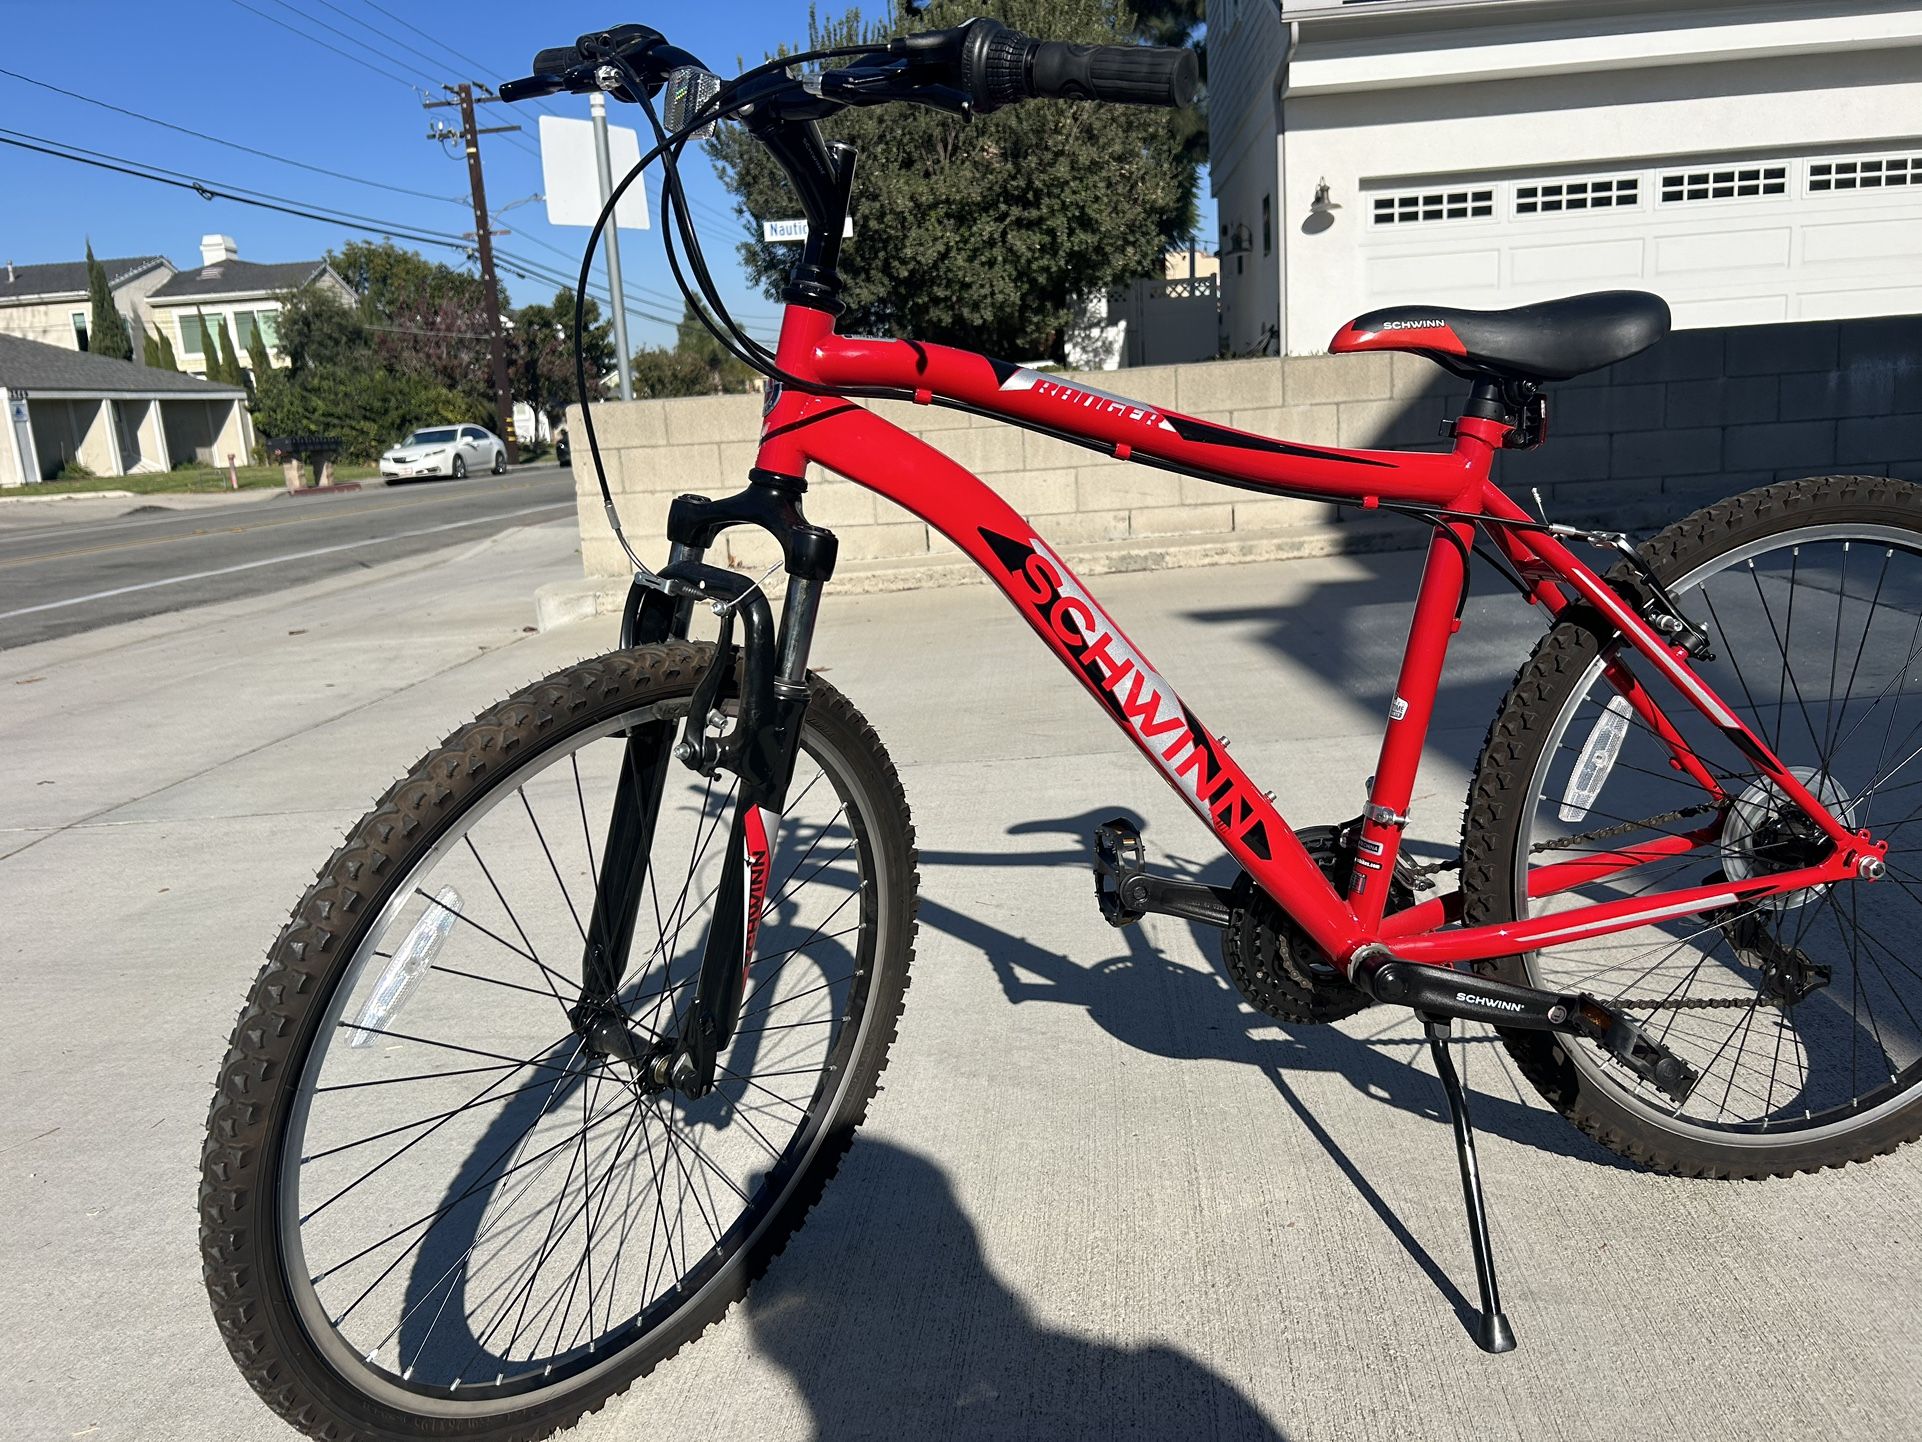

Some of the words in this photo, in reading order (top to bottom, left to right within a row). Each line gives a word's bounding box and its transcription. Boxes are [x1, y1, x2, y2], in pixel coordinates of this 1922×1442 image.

[1383, 319, 1445, 330] SCHWINN
[1012, 554, 1262, 836] SCHWINN
[1456, 992, 1521, 1012] SCHWINN
